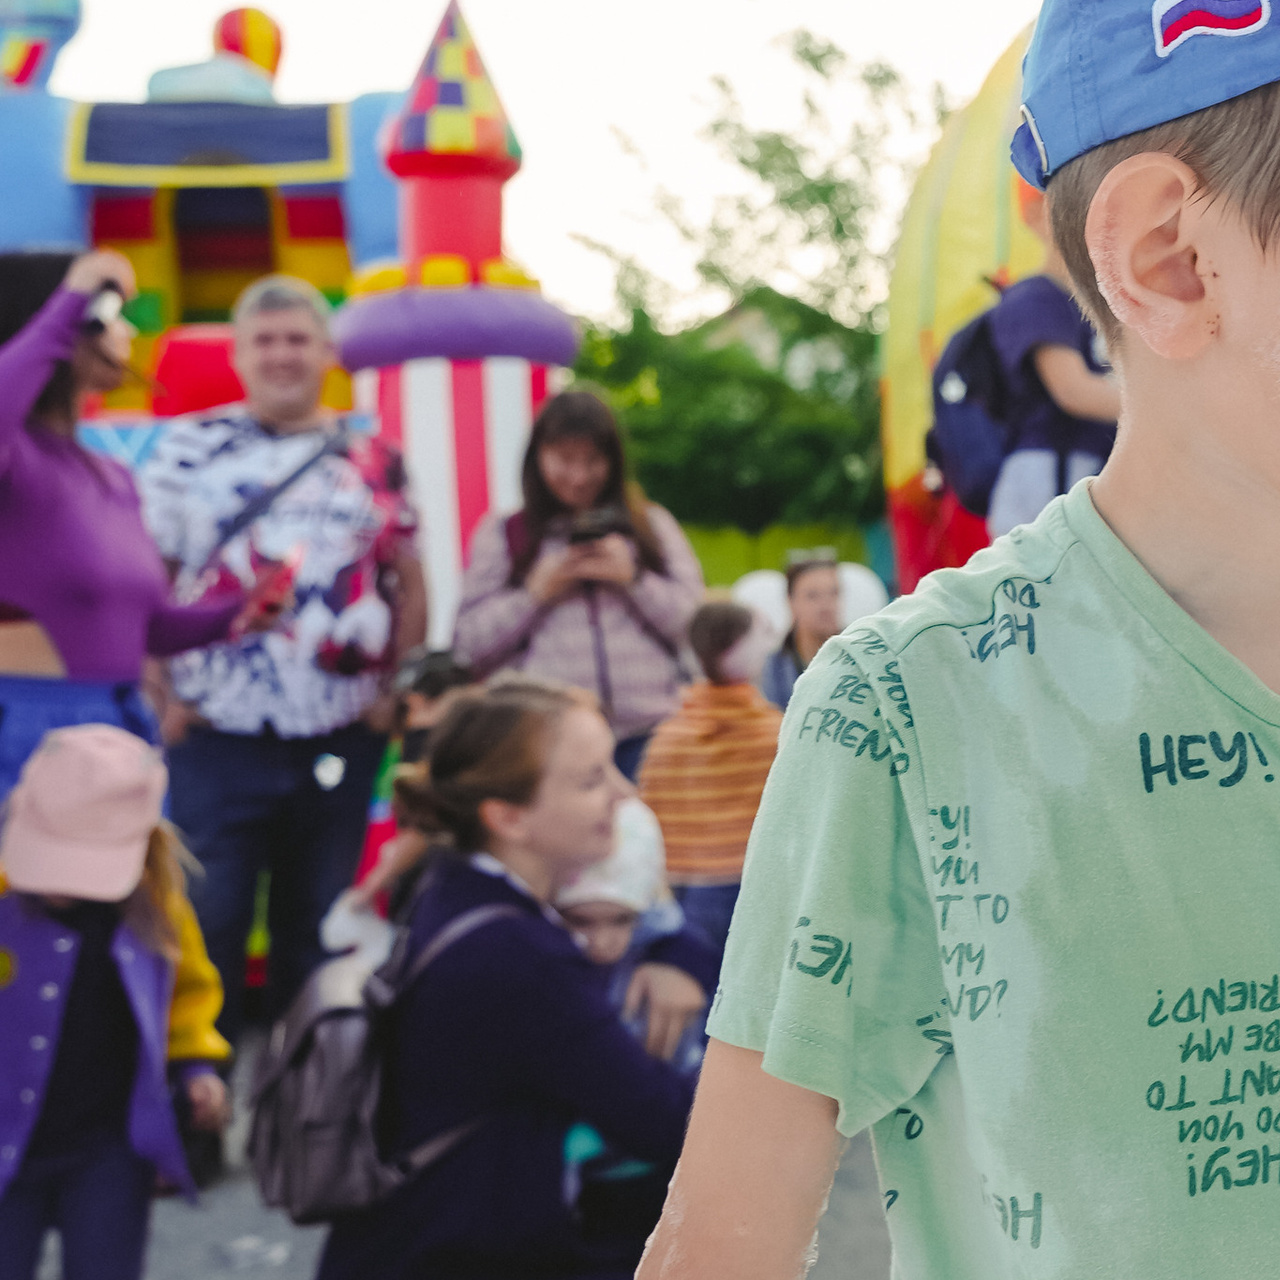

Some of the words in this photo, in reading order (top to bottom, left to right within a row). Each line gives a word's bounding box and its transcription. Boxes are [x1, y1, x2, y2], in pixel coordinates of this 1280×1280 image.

[1138, 730, 1275, 794] HEY!
[1178, 1024, 1234, 1063] MY
[1146, 1074, 1197, 1111] TO
[1177, 1110, 1245, 1143] YOU
